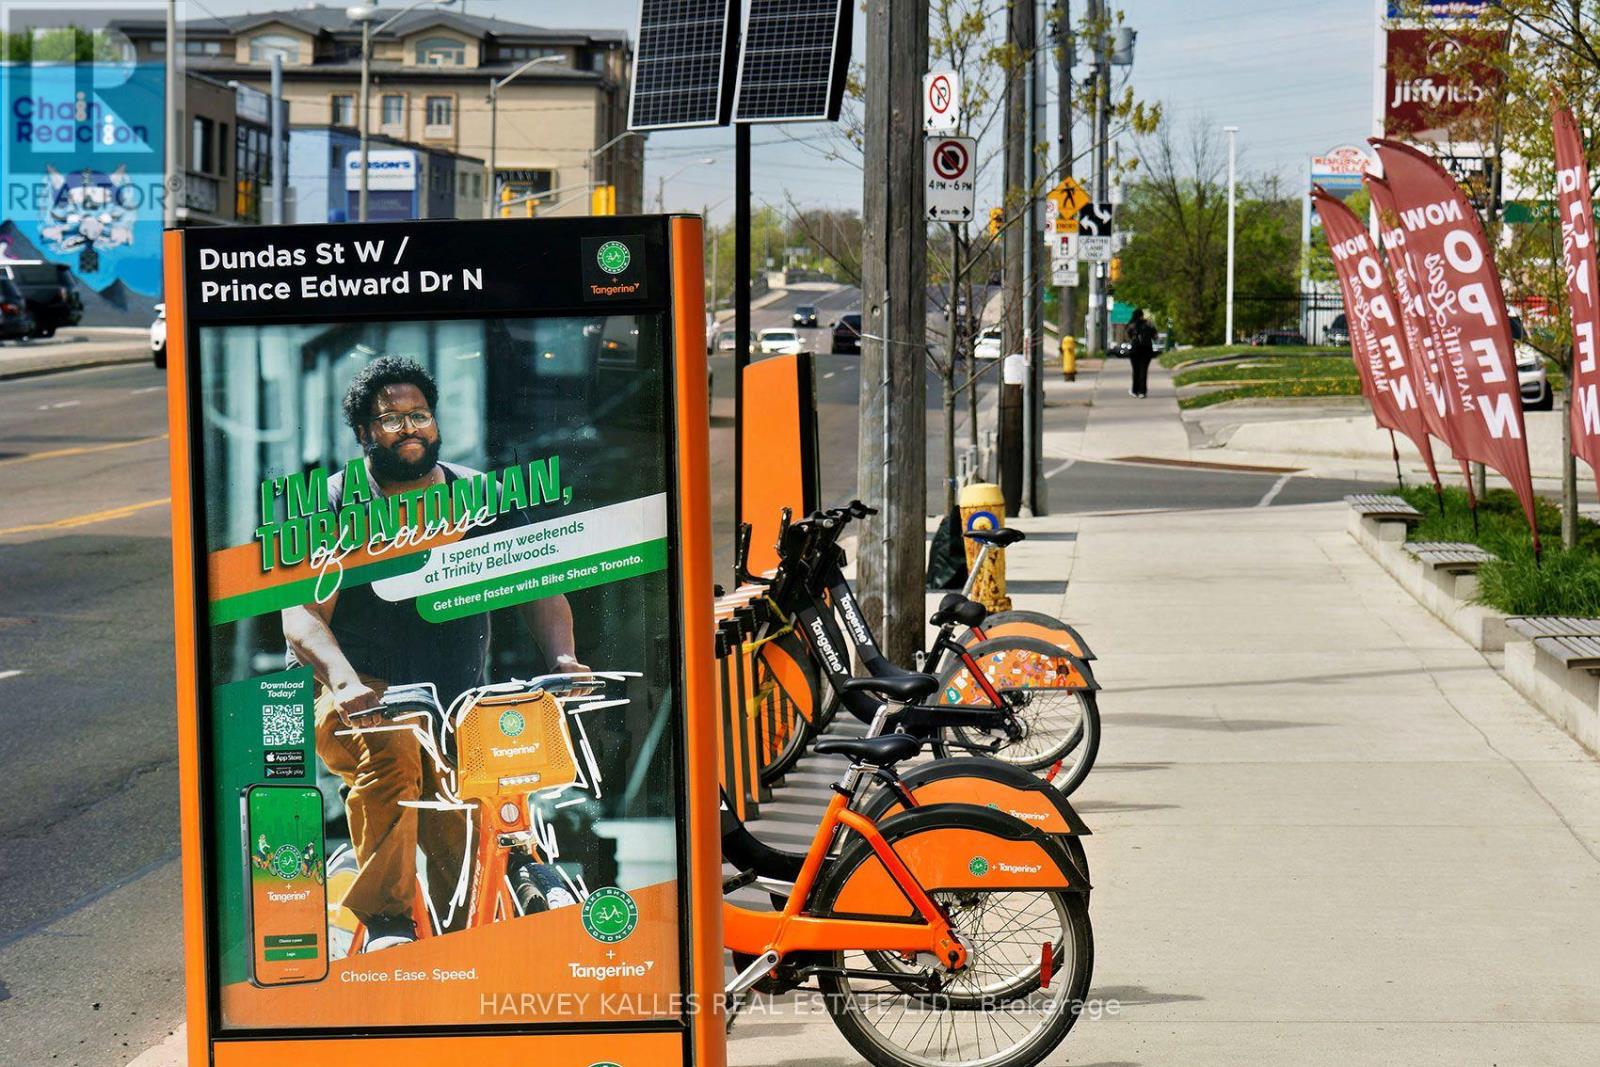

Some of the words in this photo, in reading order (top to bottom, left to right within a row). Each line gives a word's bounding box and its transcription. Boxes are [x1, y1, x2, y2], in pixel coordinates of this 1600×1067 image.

[13, 91, 102, 122] Chain
[1391, 79, 1446, 108] jiffy
[1447, 80, 1492, 103] lub
[16, 114, 148, 145] Reaction
[929, 179, 934, 190] 4
[954, 180, 960, 191] 6
[200, 245, 306, 270] Dundas
[316, 243, 345, 265] St
[354, 240, 385, 262] W
[393, 236, 410, 264] /
[201, 280, 291, 302] Prince
[301, 271, 410, 299] Edward
[420, 270, 453, 292] Dr
[462, 268, 483, 291] N
[591, 283, 635, 296] Tangerine
[262, 467, 329, 526] I'M
[342, 457, 370, 506] A
[310, 524, 353, 604] of
[368, 506, 497, 556] course
[441, 553, 446, 564] I
[449, 542, 490, 565] spend
[493, 538, 513, 552] my
[516, 521, 584, 546] weekends
[425, 572, 439, 583] at
[441, 560, 483, 581] Trinity
[487, 543, 559, 570] Bellwoods.
[433, 599, 453, 611] Get
[454, 593, 481, 607] there
[483, 586, 514, 602] faster
[516, 579, 539, 592] with
[541, 573, 565, 585] Bike
[567, 565, 598, 581] Share
[600, 555, 644, 572] Toronto.
[840, 593, 867, 643] Tangerine
[810, 617, 842, 672] Tangerine
[261, 681, 304, 690] Download
[267, 690, 296, 699] Today!
[490, 744, 536, 757] Tangerine
[999, 862, 1038, 874] Tangerine
[267, 890, 306, 903] Tangerine
[585, 891, 601, 911] BIKE
[606, 889, 634, 910] SHARE
[588, 924, 633, 941] TORONTO
[341, 970, 391, 982] Choice.
[394, 969, 430, 981] Ease.
[432, 968, 479, 983] Speed.
[568, 962, 645, 981] Tangerine
